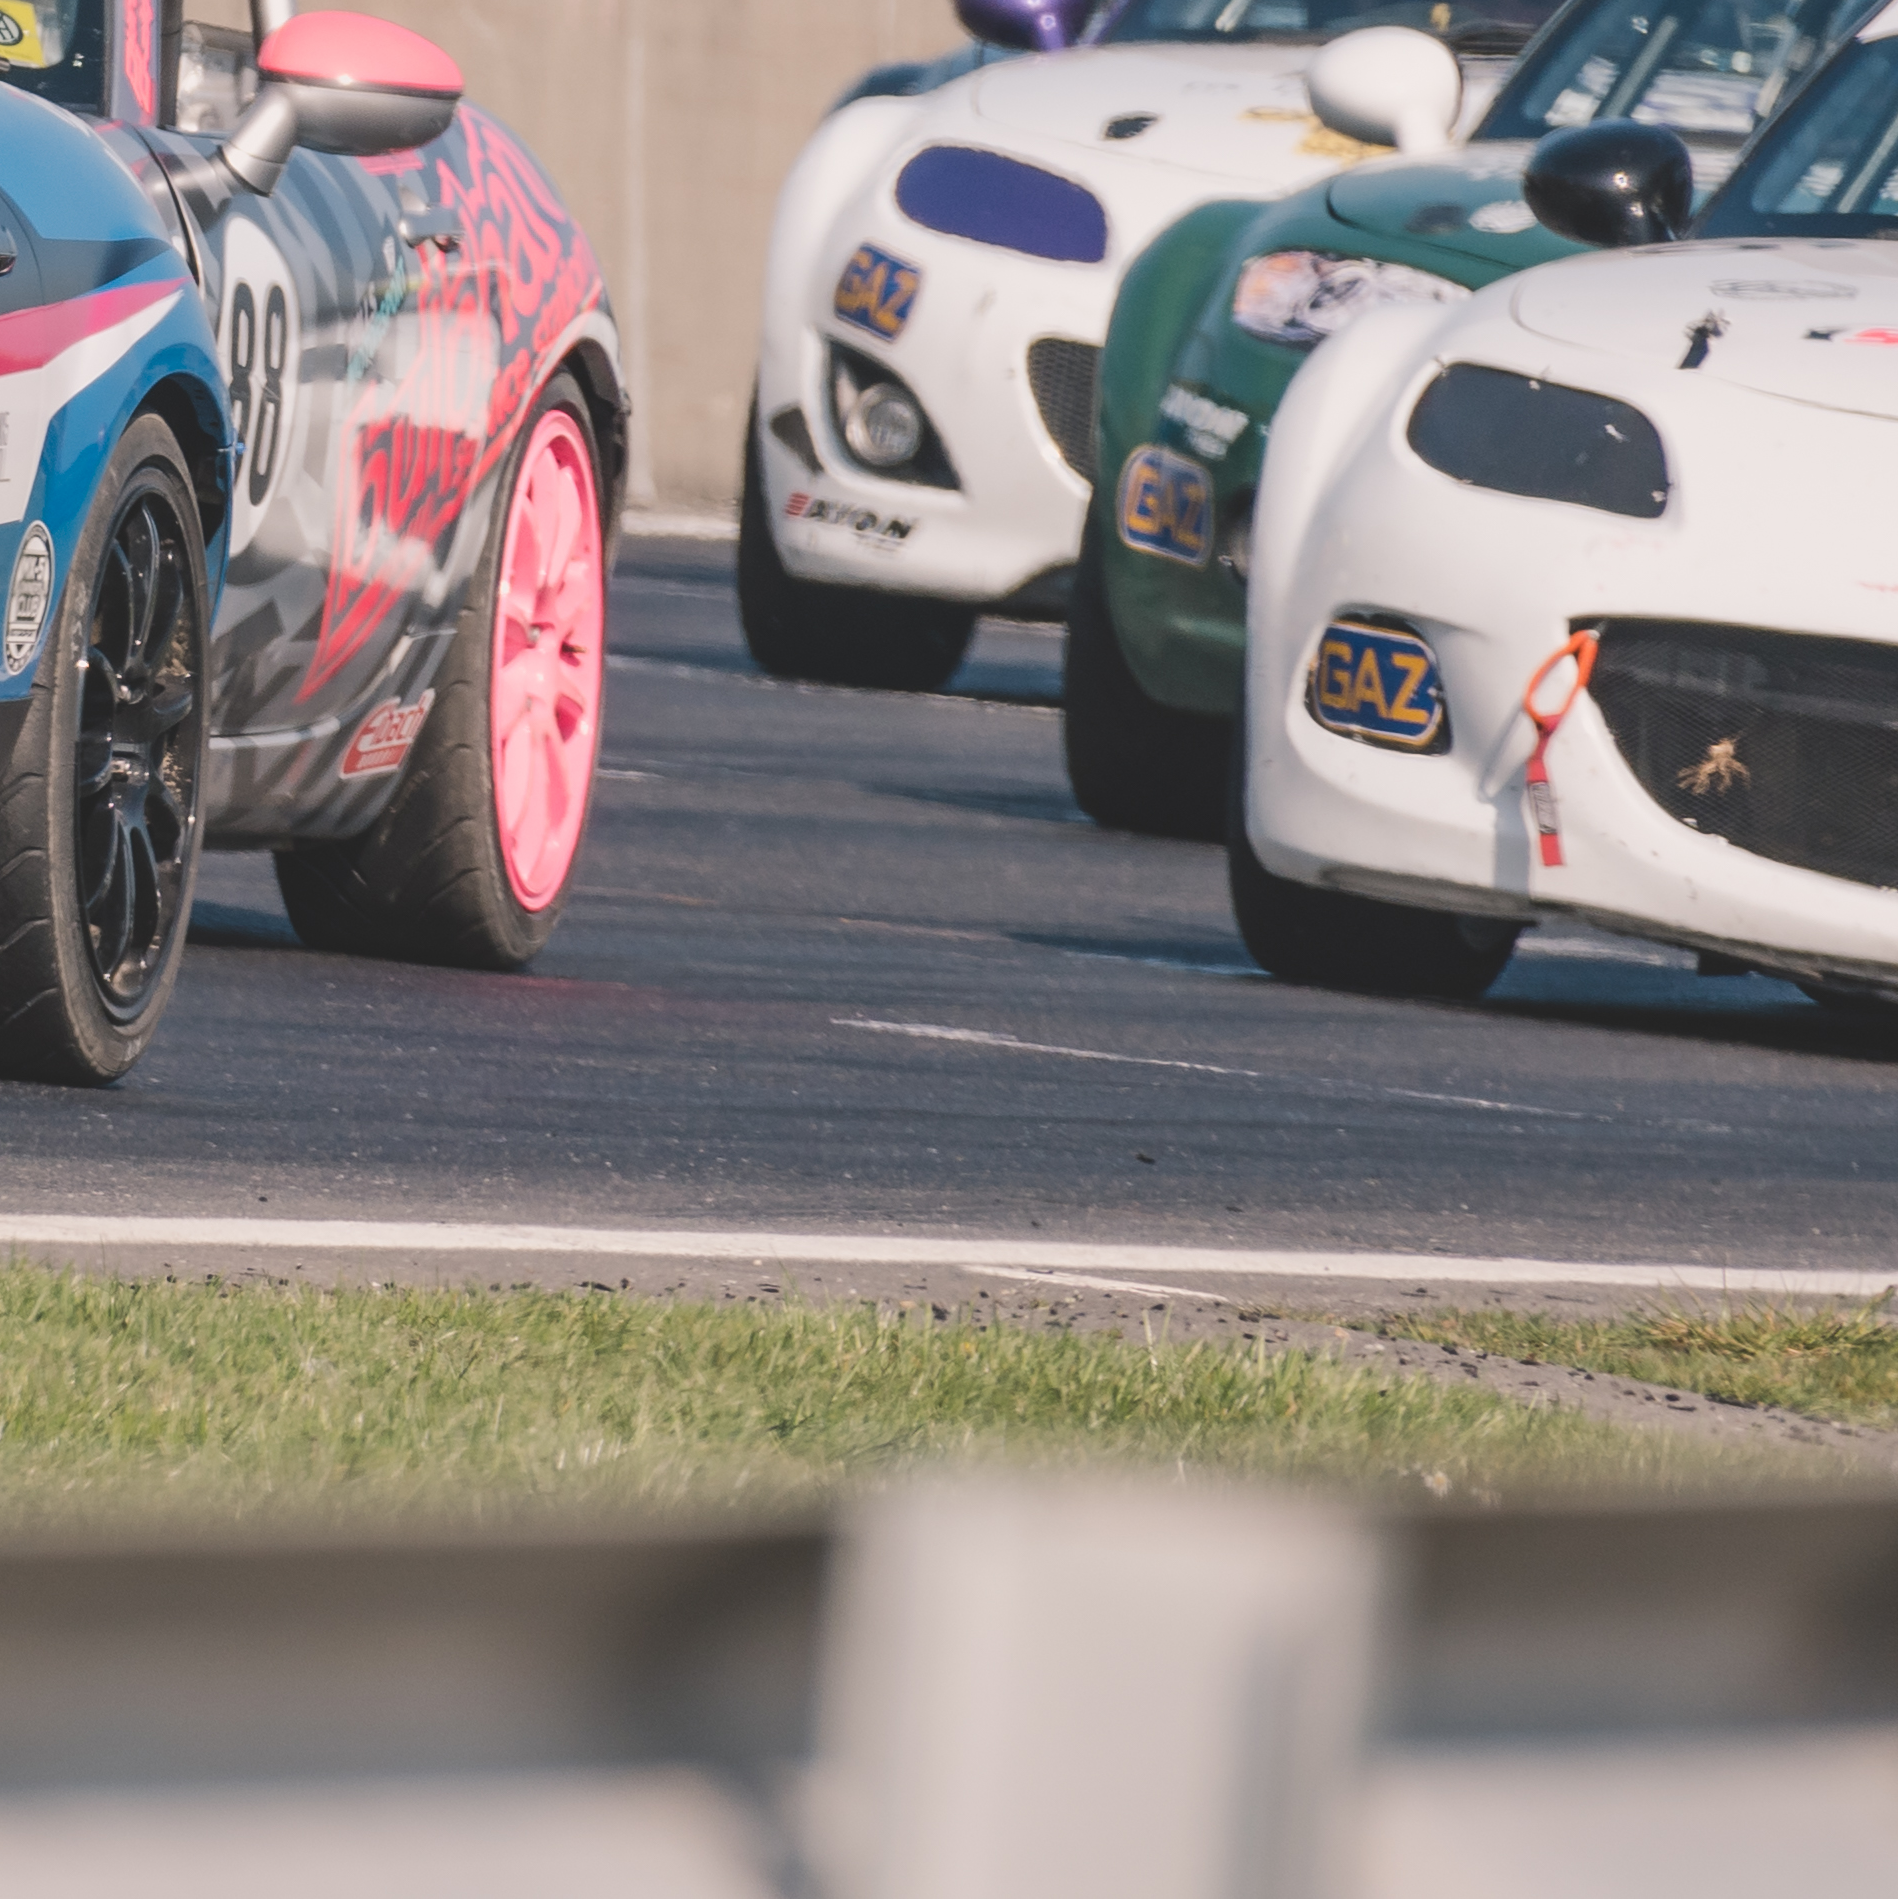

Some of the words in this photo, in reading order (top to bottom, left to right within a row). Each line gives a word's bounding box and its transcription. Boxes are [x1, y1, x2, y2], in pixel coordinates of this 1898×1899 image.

[835, 249, 920, 333] GAZ
[1124, 464, 1205, 547] GAZ
[1321, 640, 1432, 724] GAZ
